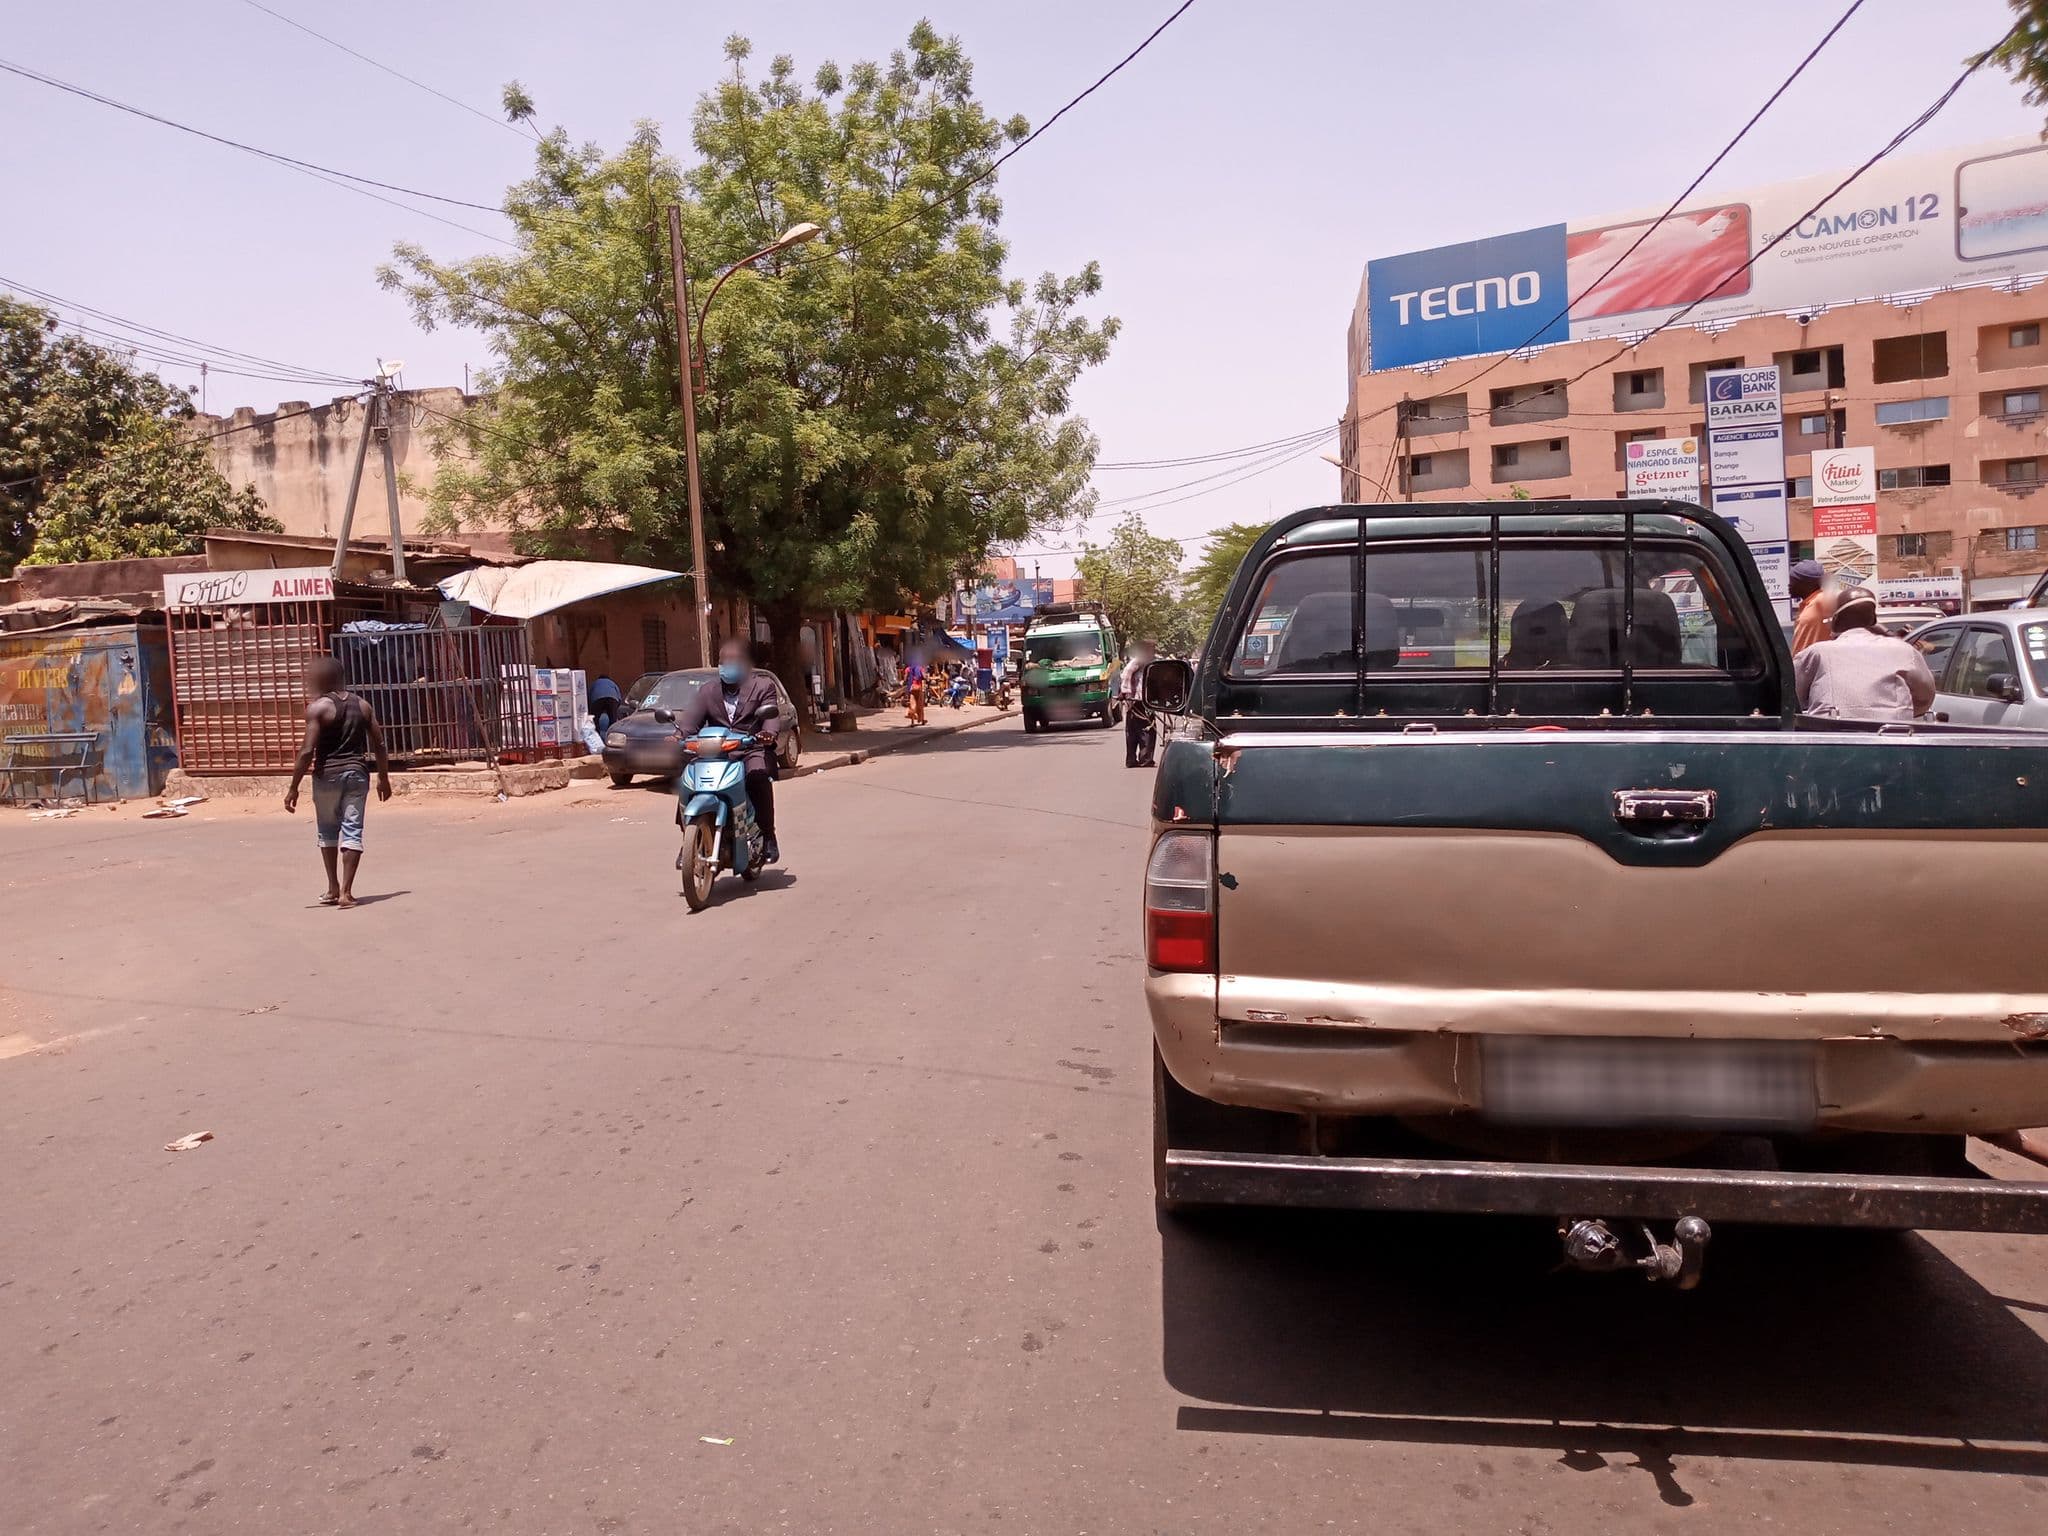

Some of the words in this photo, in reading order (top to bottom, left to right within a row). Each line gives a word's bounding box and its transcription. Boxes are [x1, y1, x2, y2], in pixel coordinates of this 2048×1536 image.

[1761, 232, 1792, 245] Sée
[1795, 205, 1898, 240] CAMON
[1905, 193, 1939, 222] 12
[1819, 238, 1861, 251] NOUVELLE
[1390, 271, 1541, 326] TECNO
[1742, 371, 1776, 383] CORIS
[1743, 381, 1776, 393] BANK
[1710, 401, 1777, 416] BARAKA
[1717, 433, 1745, 441] AGENCE
[1747, 431, 1775, 439] BARAKA
[1646, 448, 1678, 457] ESPACE
[1628, 459, 1670, 468] NIANGADO
[1672, 456, 1697, 465] BAZIN
[1825, 463, 1862, 480] Filini
[1635, 470, 1689, 486] getzner
[1830, 479, 1858, 487] Market
